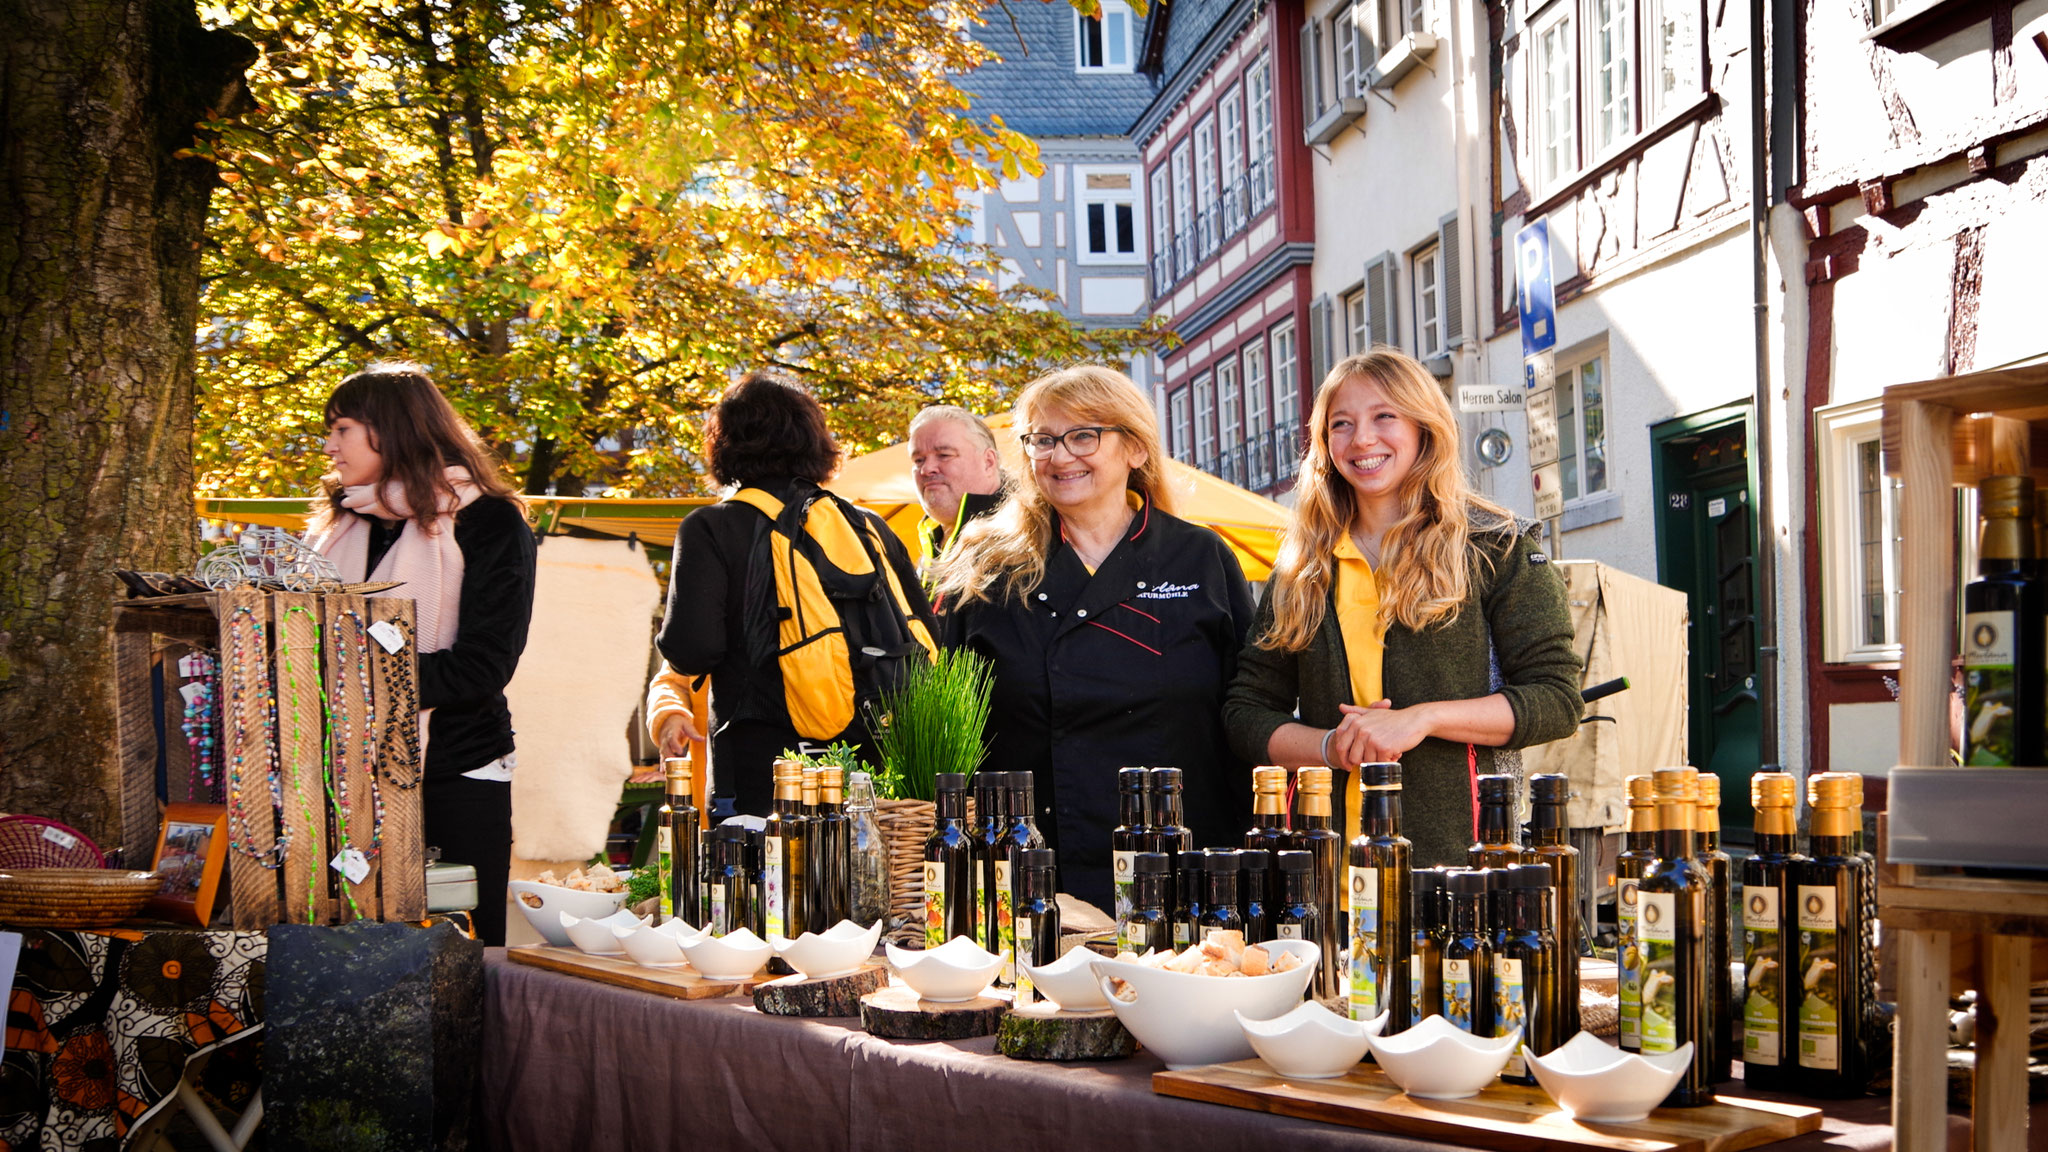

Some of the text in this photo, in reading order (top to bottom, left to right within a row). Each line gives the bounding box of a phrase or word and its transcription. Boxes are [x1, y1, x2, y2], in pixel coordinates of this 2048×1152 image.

[1522, 236, 1543, 315] P
[1462, 391, 1495, 405] Herren
[1496, 388, 1523, 405] Salon
[1671, 493, 1688, 509] 28
[1136, 591, 1188, 599] ATURMÜHLE
